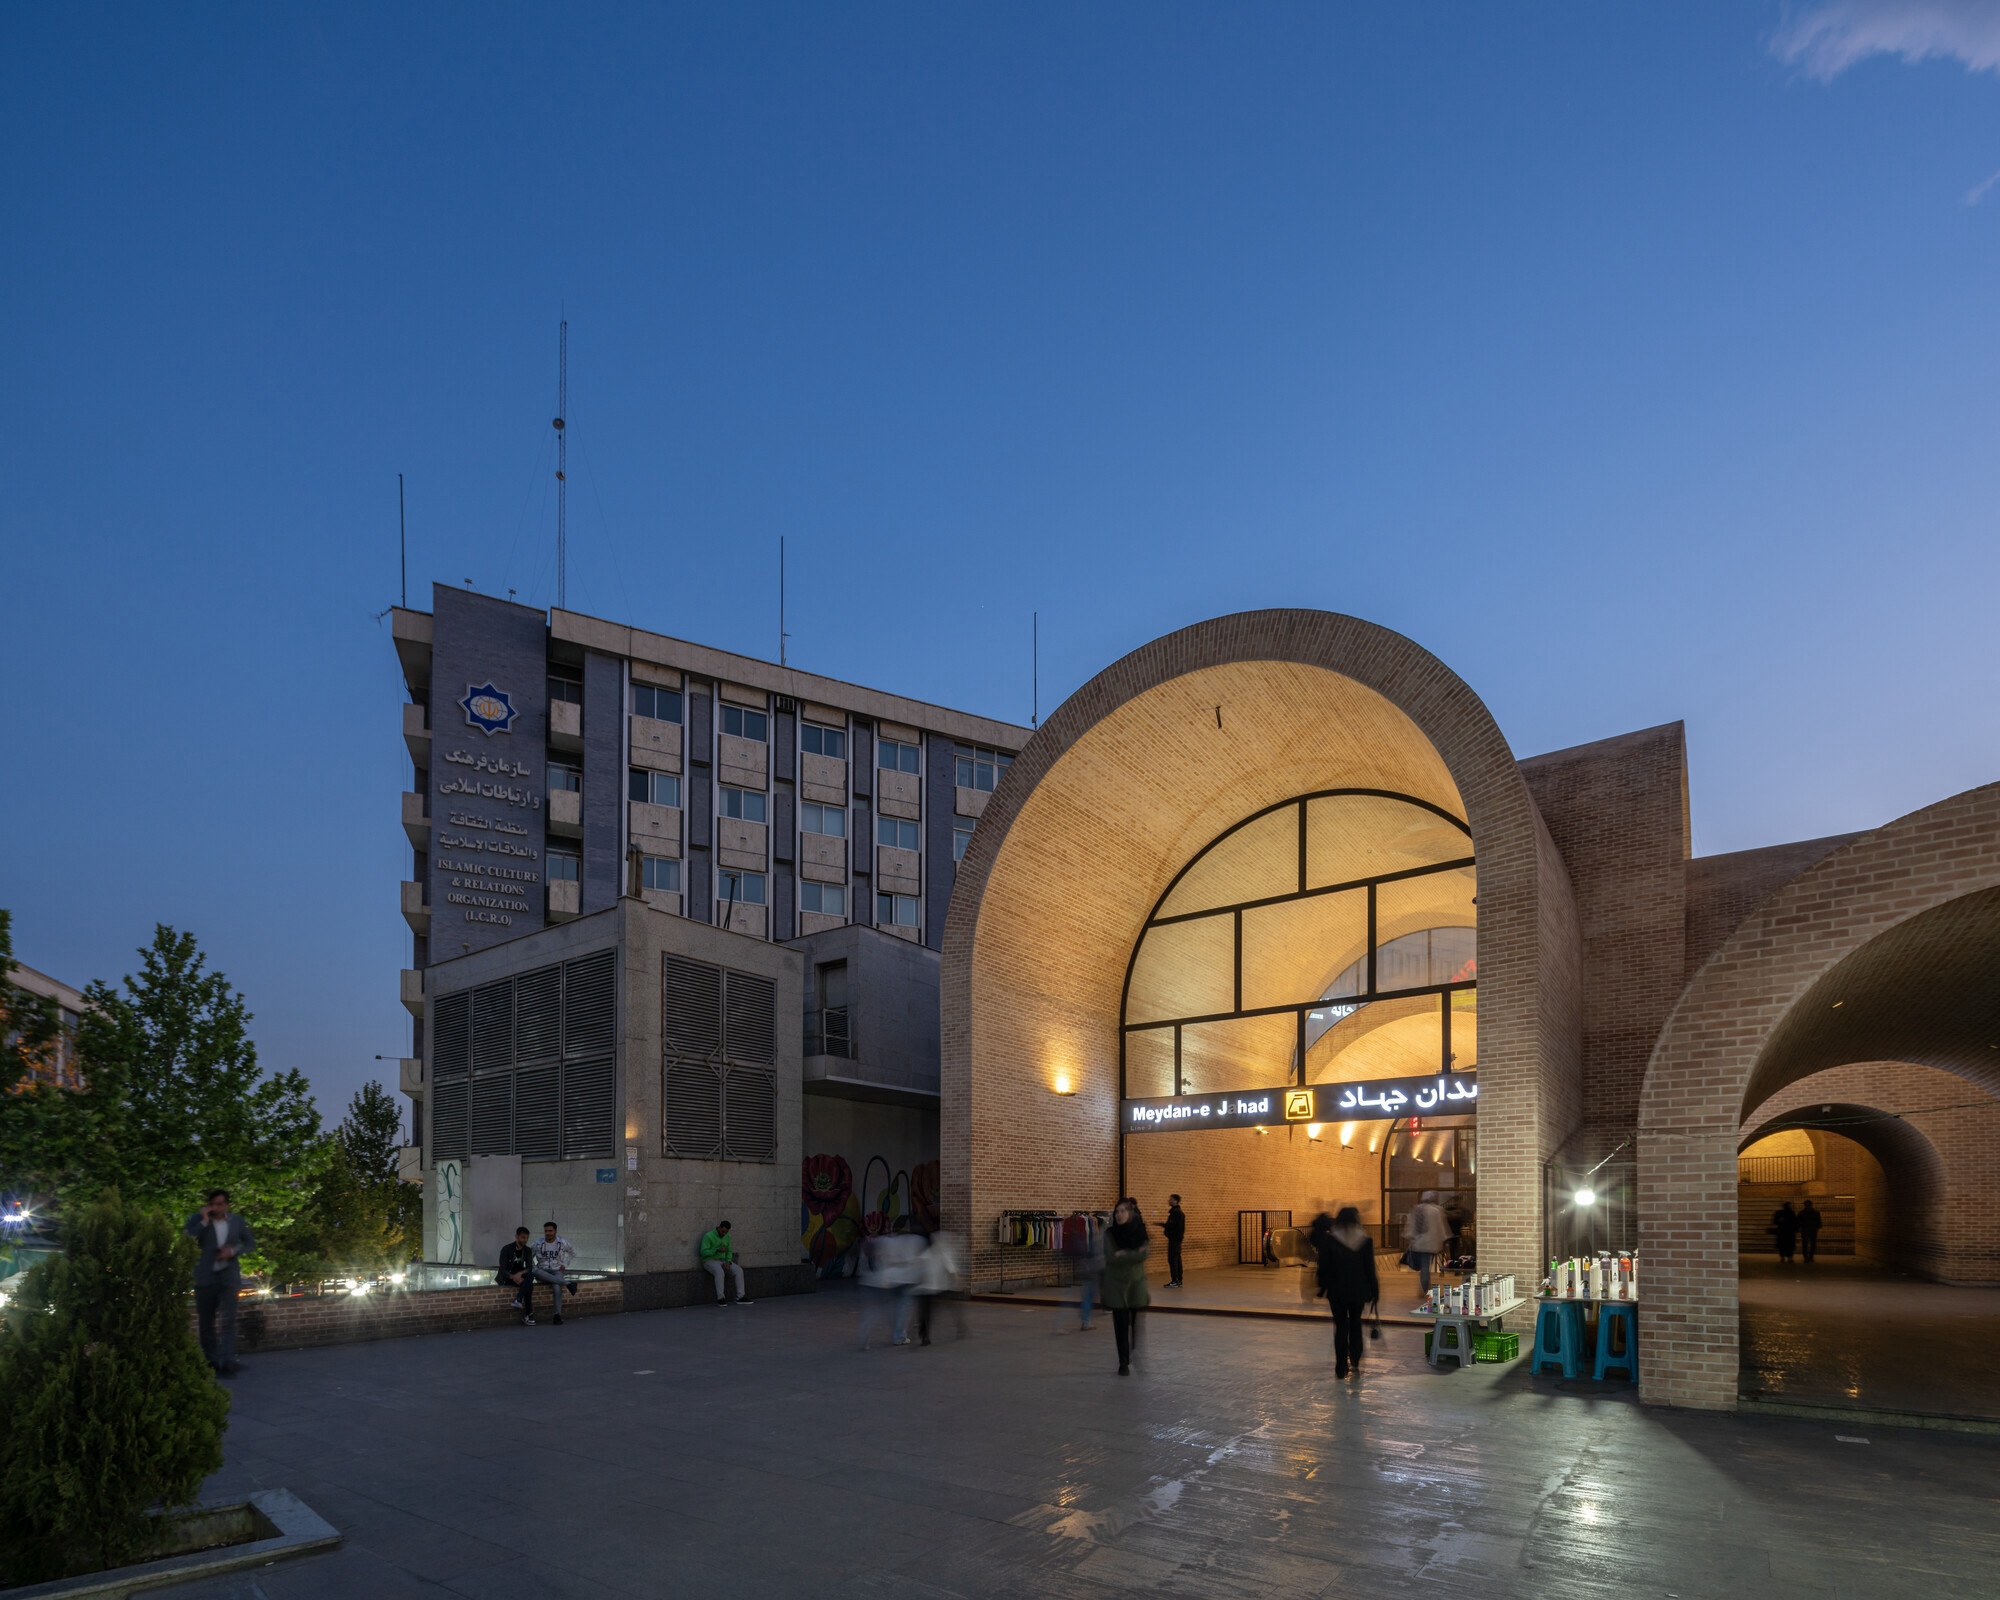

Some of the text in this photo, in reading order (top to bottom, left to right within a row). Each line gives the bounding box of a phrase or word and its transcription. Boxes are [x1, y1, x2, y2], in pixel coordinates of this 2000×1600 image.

[487, 757, 531, 778] سازمان
[439, 777, 481, 795] اسلامی
[482, 783, 531, 807] ارتباطات
[449, 811, 528, 836] منظمة الثقافة
[437, 859, 539, 882] ISLAMIC CULTURE
[451, 876, 525, 895] & RELATIONS
[447, 892, 529, 912] ORGANIZATION
[1339, 1079, 1478, 1112] یدان جهاد
[1132, 1098, 1269, 1123] Meydan-e Jahad
